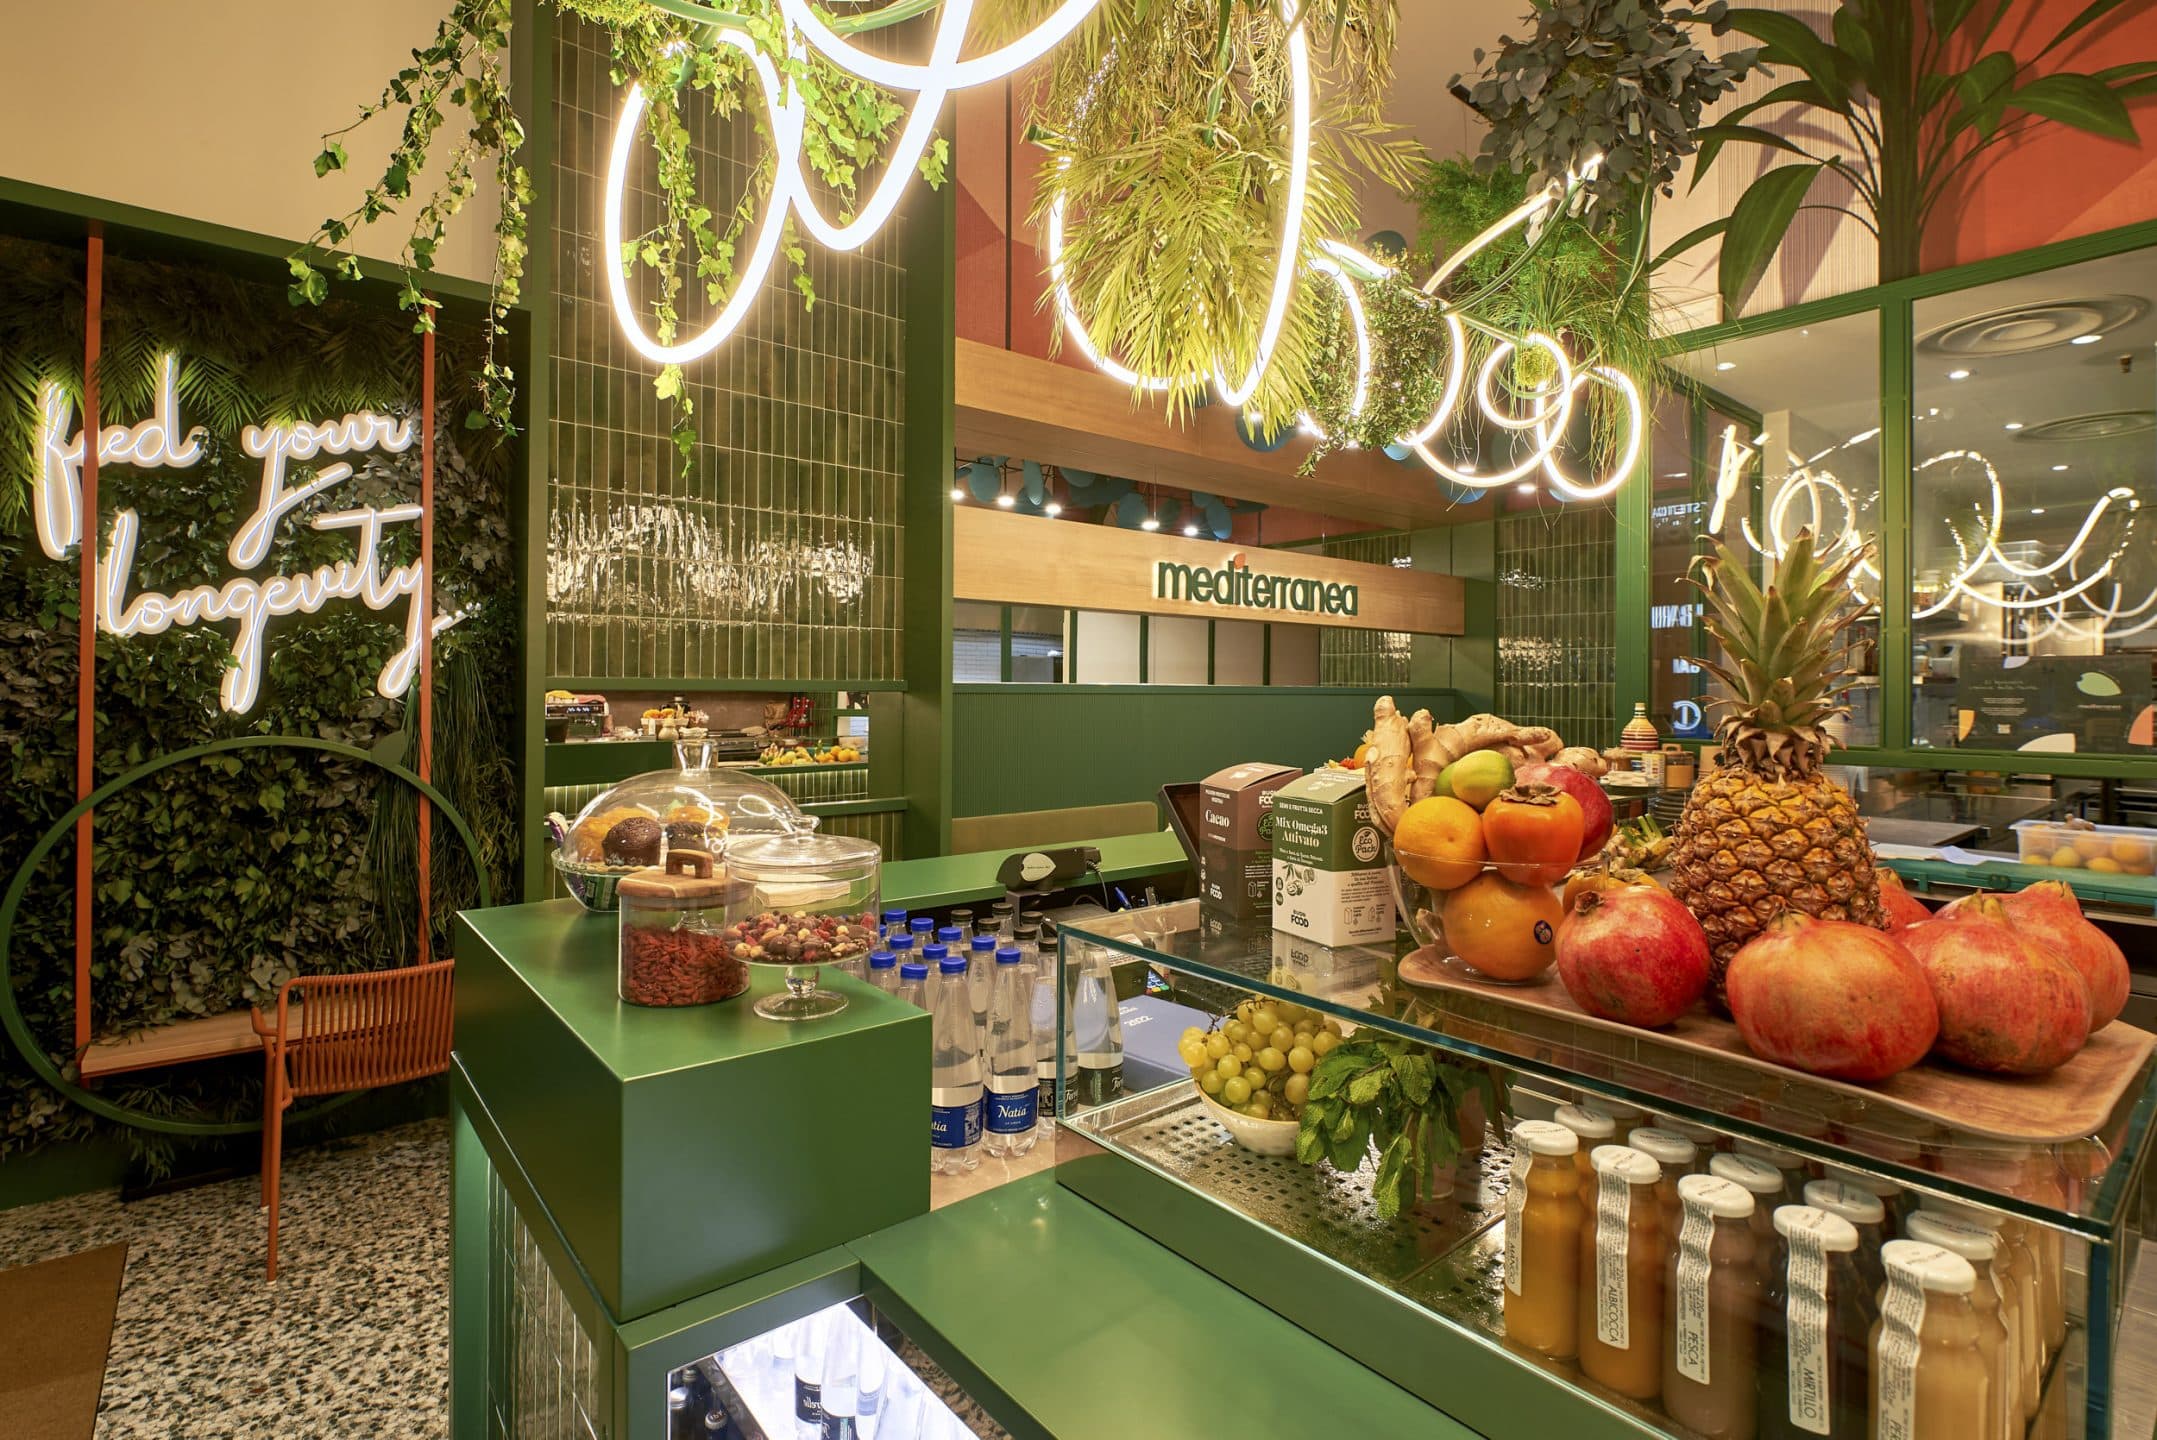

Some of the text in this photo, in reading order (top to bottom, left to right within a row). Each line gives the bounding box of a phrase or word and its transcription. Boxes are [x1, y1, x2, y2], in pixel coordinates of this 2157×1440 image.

[36, 353, 420, 569] fed your
[1157, 553, 1358, 616] mediterranea
[1205, 809, 1230, 828] Cacao
[1276, 816, 1328, 835] Mix Omega3
[1282, 830, 1320, 848] Attivato
[1359, 836, 1372, 844] Eco
[1355, 844, 1377, 854] Pack
[1291, 914, 1309, 928] FOOD
[1608, 1285, 1619, 1343] ALBICOCCA
[1688, 1331, 1699, 1366] PESCA
[1803, 1367, 1817, 1419] MIRTILLO
